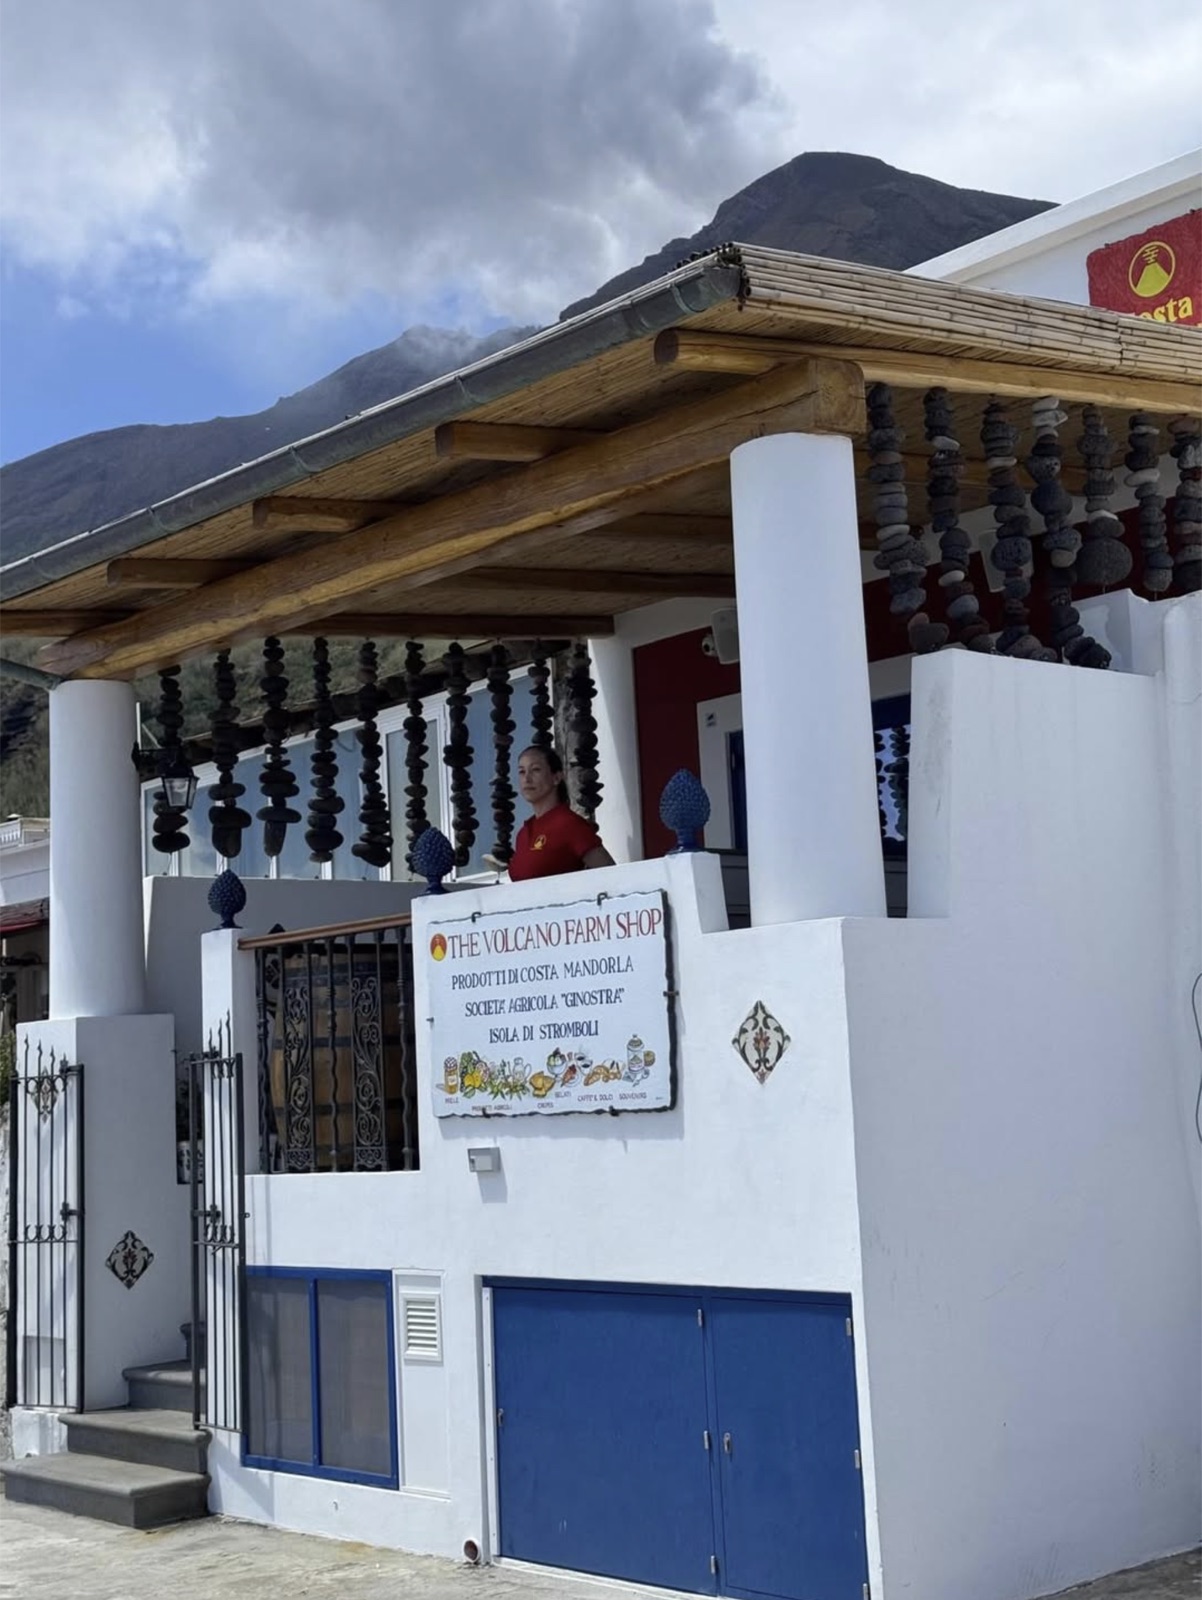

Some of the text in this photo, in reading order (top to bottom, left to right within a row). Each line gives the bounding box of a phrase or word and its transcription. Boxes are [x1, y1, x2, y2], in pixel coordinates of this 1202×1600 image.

[448, 908, 662, 959] THE VOLCANO FARM SHOP
[452, 955, 634, 990] PRODOTTI DI COSTA MANDORLA
[508, 995, 559, 1014] AGRICOLA
[489, 1020, 599, 1044] ISOLA DI STROMBOLI
